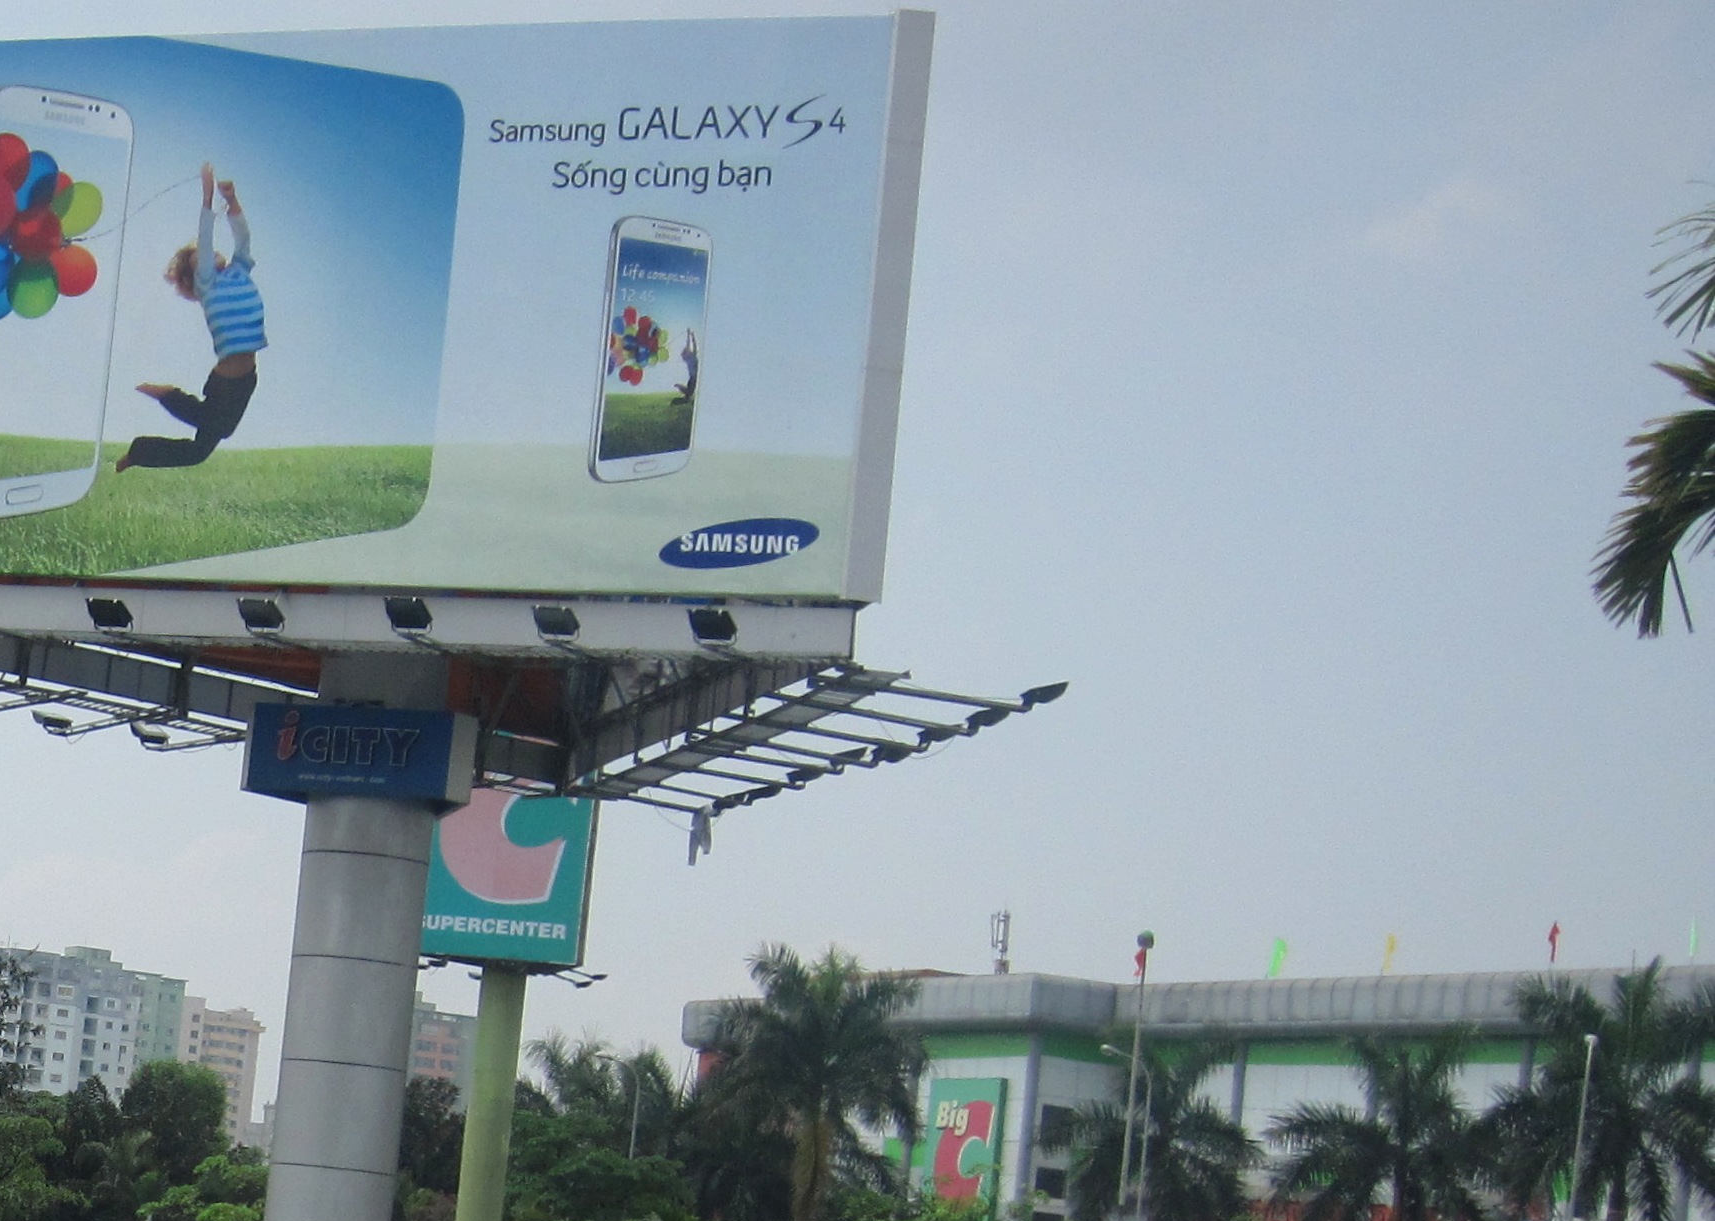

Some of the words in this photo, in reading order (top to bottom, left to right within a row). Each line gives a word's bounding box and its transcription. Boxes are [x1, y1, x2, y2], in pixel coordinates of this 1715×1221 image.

[488, 118, 606, 148] Samsung
[617, 104, 780, 142] GALAXY
[551, 160, 628, 195] Sống
[634, 160, 709, 194] cùng
[717, 159, 773, 194] bạn
[679, 532, 800, 556] SAMSUNG
[936, 1100, 970, 1137] Big
